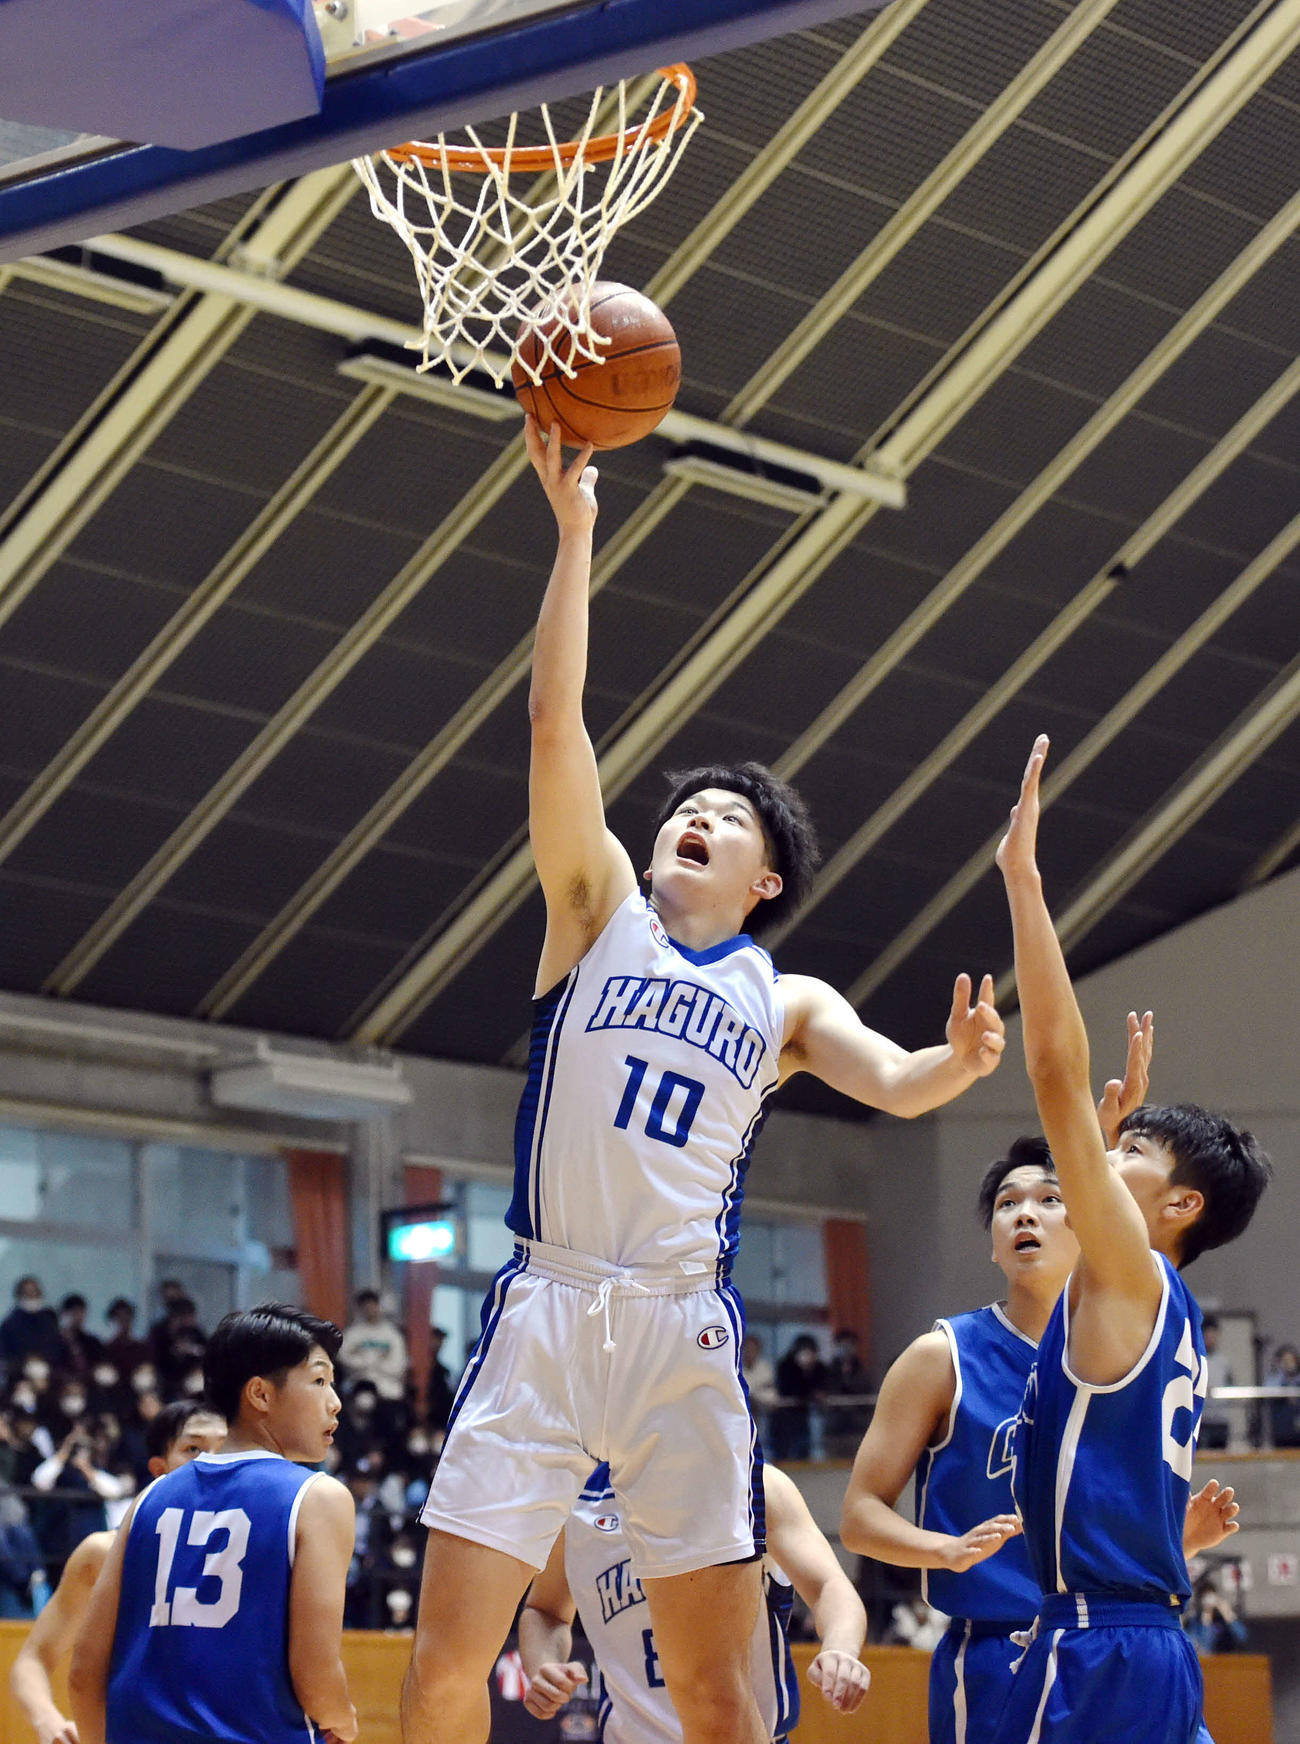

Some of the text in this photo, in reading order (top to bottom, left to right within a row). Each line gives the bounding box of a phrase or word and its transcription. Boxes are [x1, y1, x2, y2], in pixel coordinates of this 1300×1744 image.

[585, 975, 767, 1090] HAGURO
[613, 1055, 706, 1148] 10
[149, 1507, 252, 1628] 13
